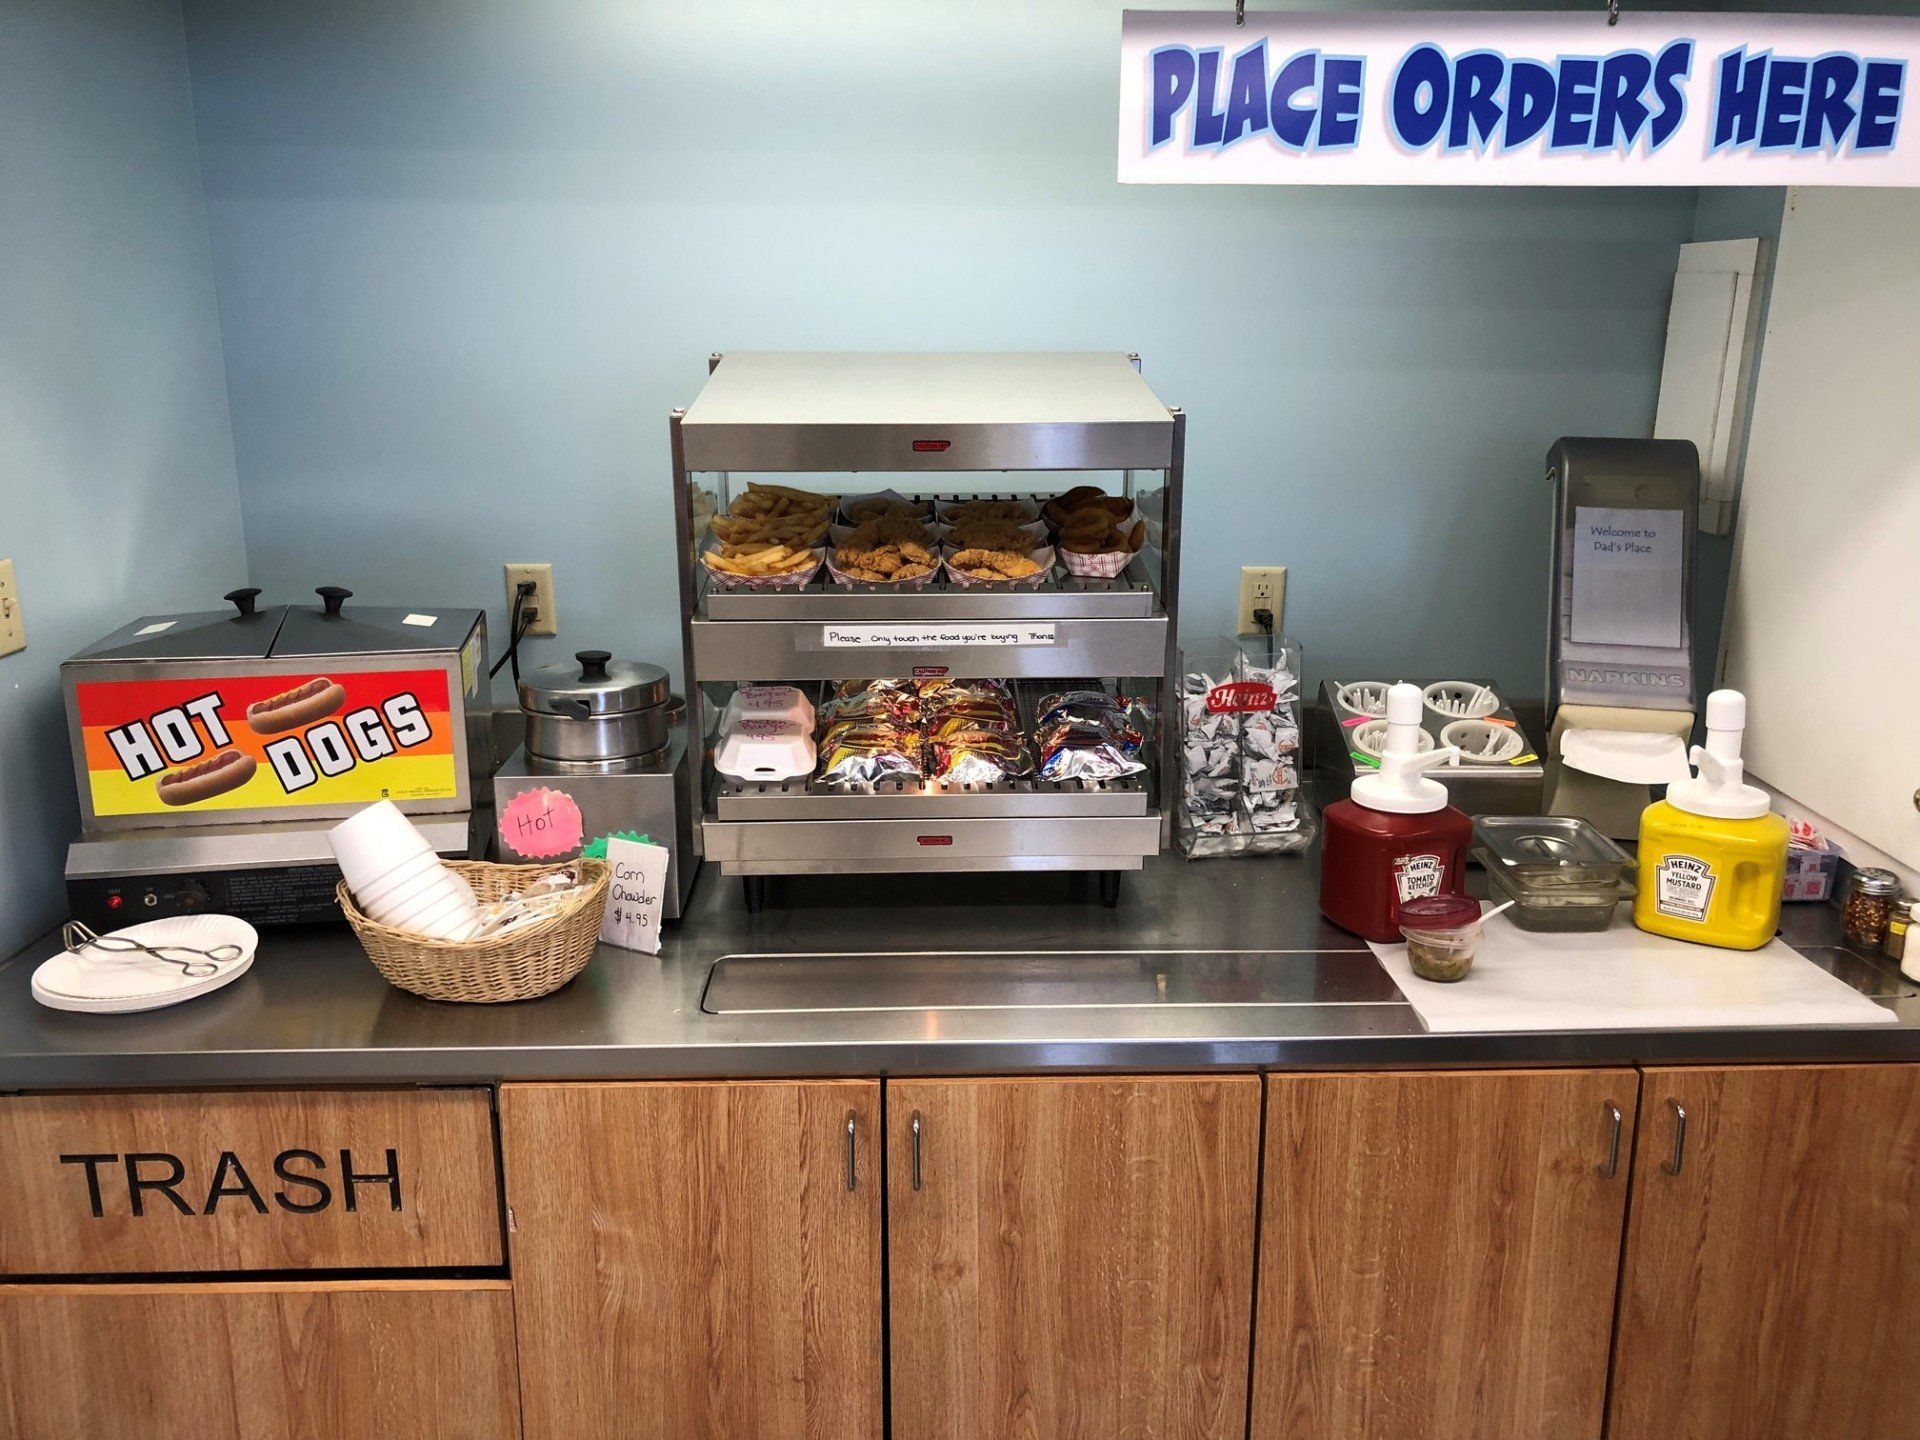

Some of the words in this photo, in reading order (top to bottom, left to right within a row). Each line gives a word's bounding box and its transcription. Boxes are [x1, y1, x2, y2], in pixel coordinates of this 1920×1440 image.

[1148, 37, 1367, 154] PLACE
[1387, 38, 1696, 156] ORDERS
[1704, 43, 1908, 157] HERE
[1590, 526, 1641, 538] Welcome
[1644, 529, 1656, 538] to
[1593, 541, 1622, 552] Dad's
[1624, 542, 1652, 554] Place
[871, 634, 891, 645] Only
[893, 634, 919, 642] touch
[921, 633, 937, 641] the
[940, 633, 960, 641] food
[961, 632, 987, 644] you're
[990, 632, 1019, 644] buying
[1567, 667, 1686, 688] NAPKINS
[1211, 687, 1272, 708] Heinz
[104, 691, 233, 782] HOT
[263, 692, 433, 794] DOGS
[615, 861, 645, 884] Corn
[1410, 861, 1434, 871] HEINZ
[1670, 860, 1702, 874] HEINZ
[1407, 873, 1435, 885] TOMATO
[1671, 871, 1698, 882] YELLOW
[1408, 882, 1434, 890] KETCHUP
[1666, 877, 1702, 891] MUSTARD
[59, 1147, 403, 1218] TRASH
